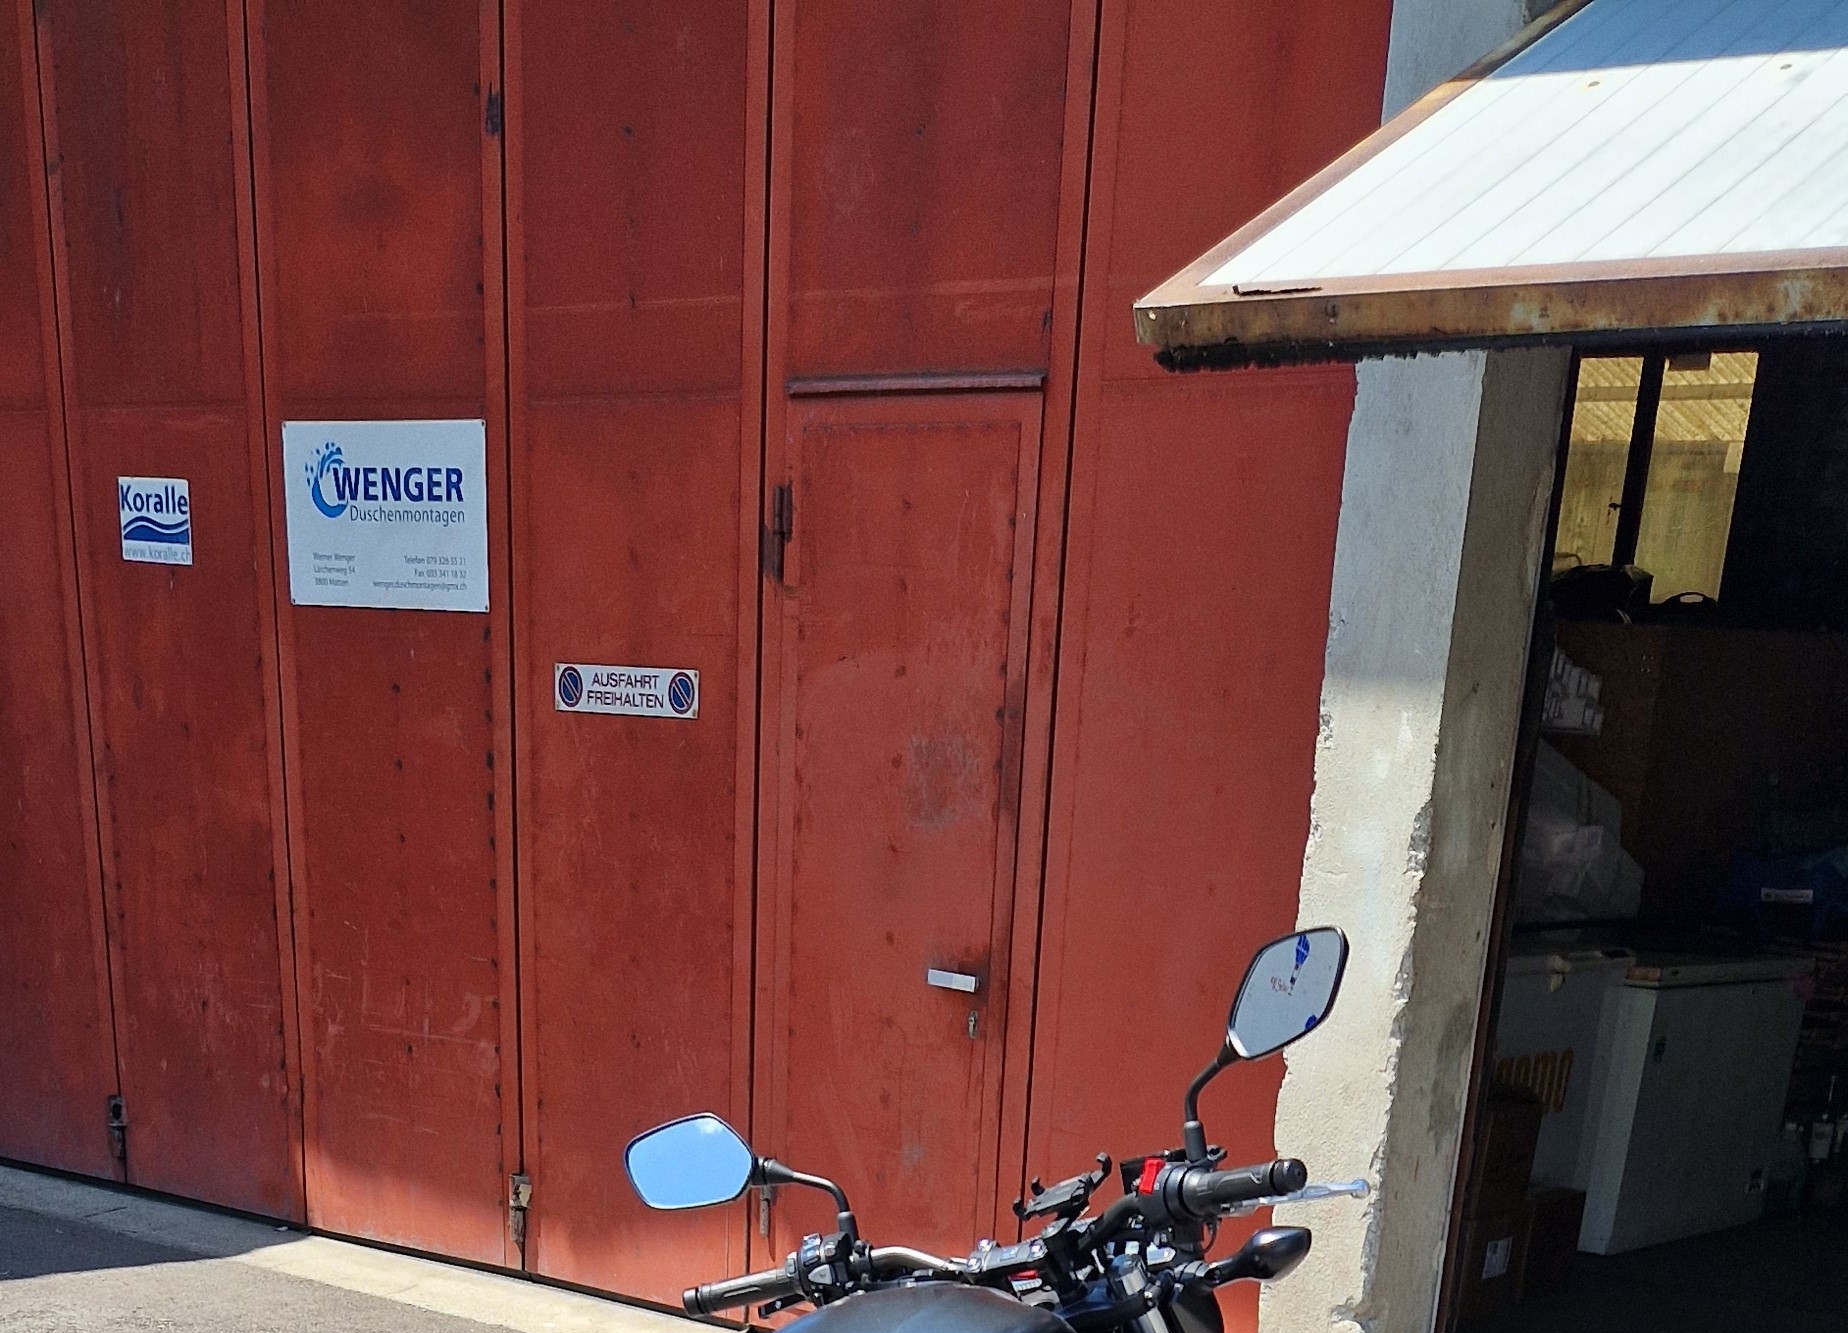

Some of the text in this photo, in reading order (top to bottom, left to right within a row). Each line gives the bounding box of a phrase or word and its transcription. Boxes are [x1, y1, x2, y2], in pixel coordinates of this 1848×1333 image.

[332, 467, 465, 503] WENGER
[120, 484, 189, 515] Koralle
[350, 505, 466, 527] Duschenmontagen
[125, 546, 191, 562] www.koralle.ch
[591, 672, 660, 691] AUSFAHRT
[586, 690, 664, 709] FREIHALTEN
